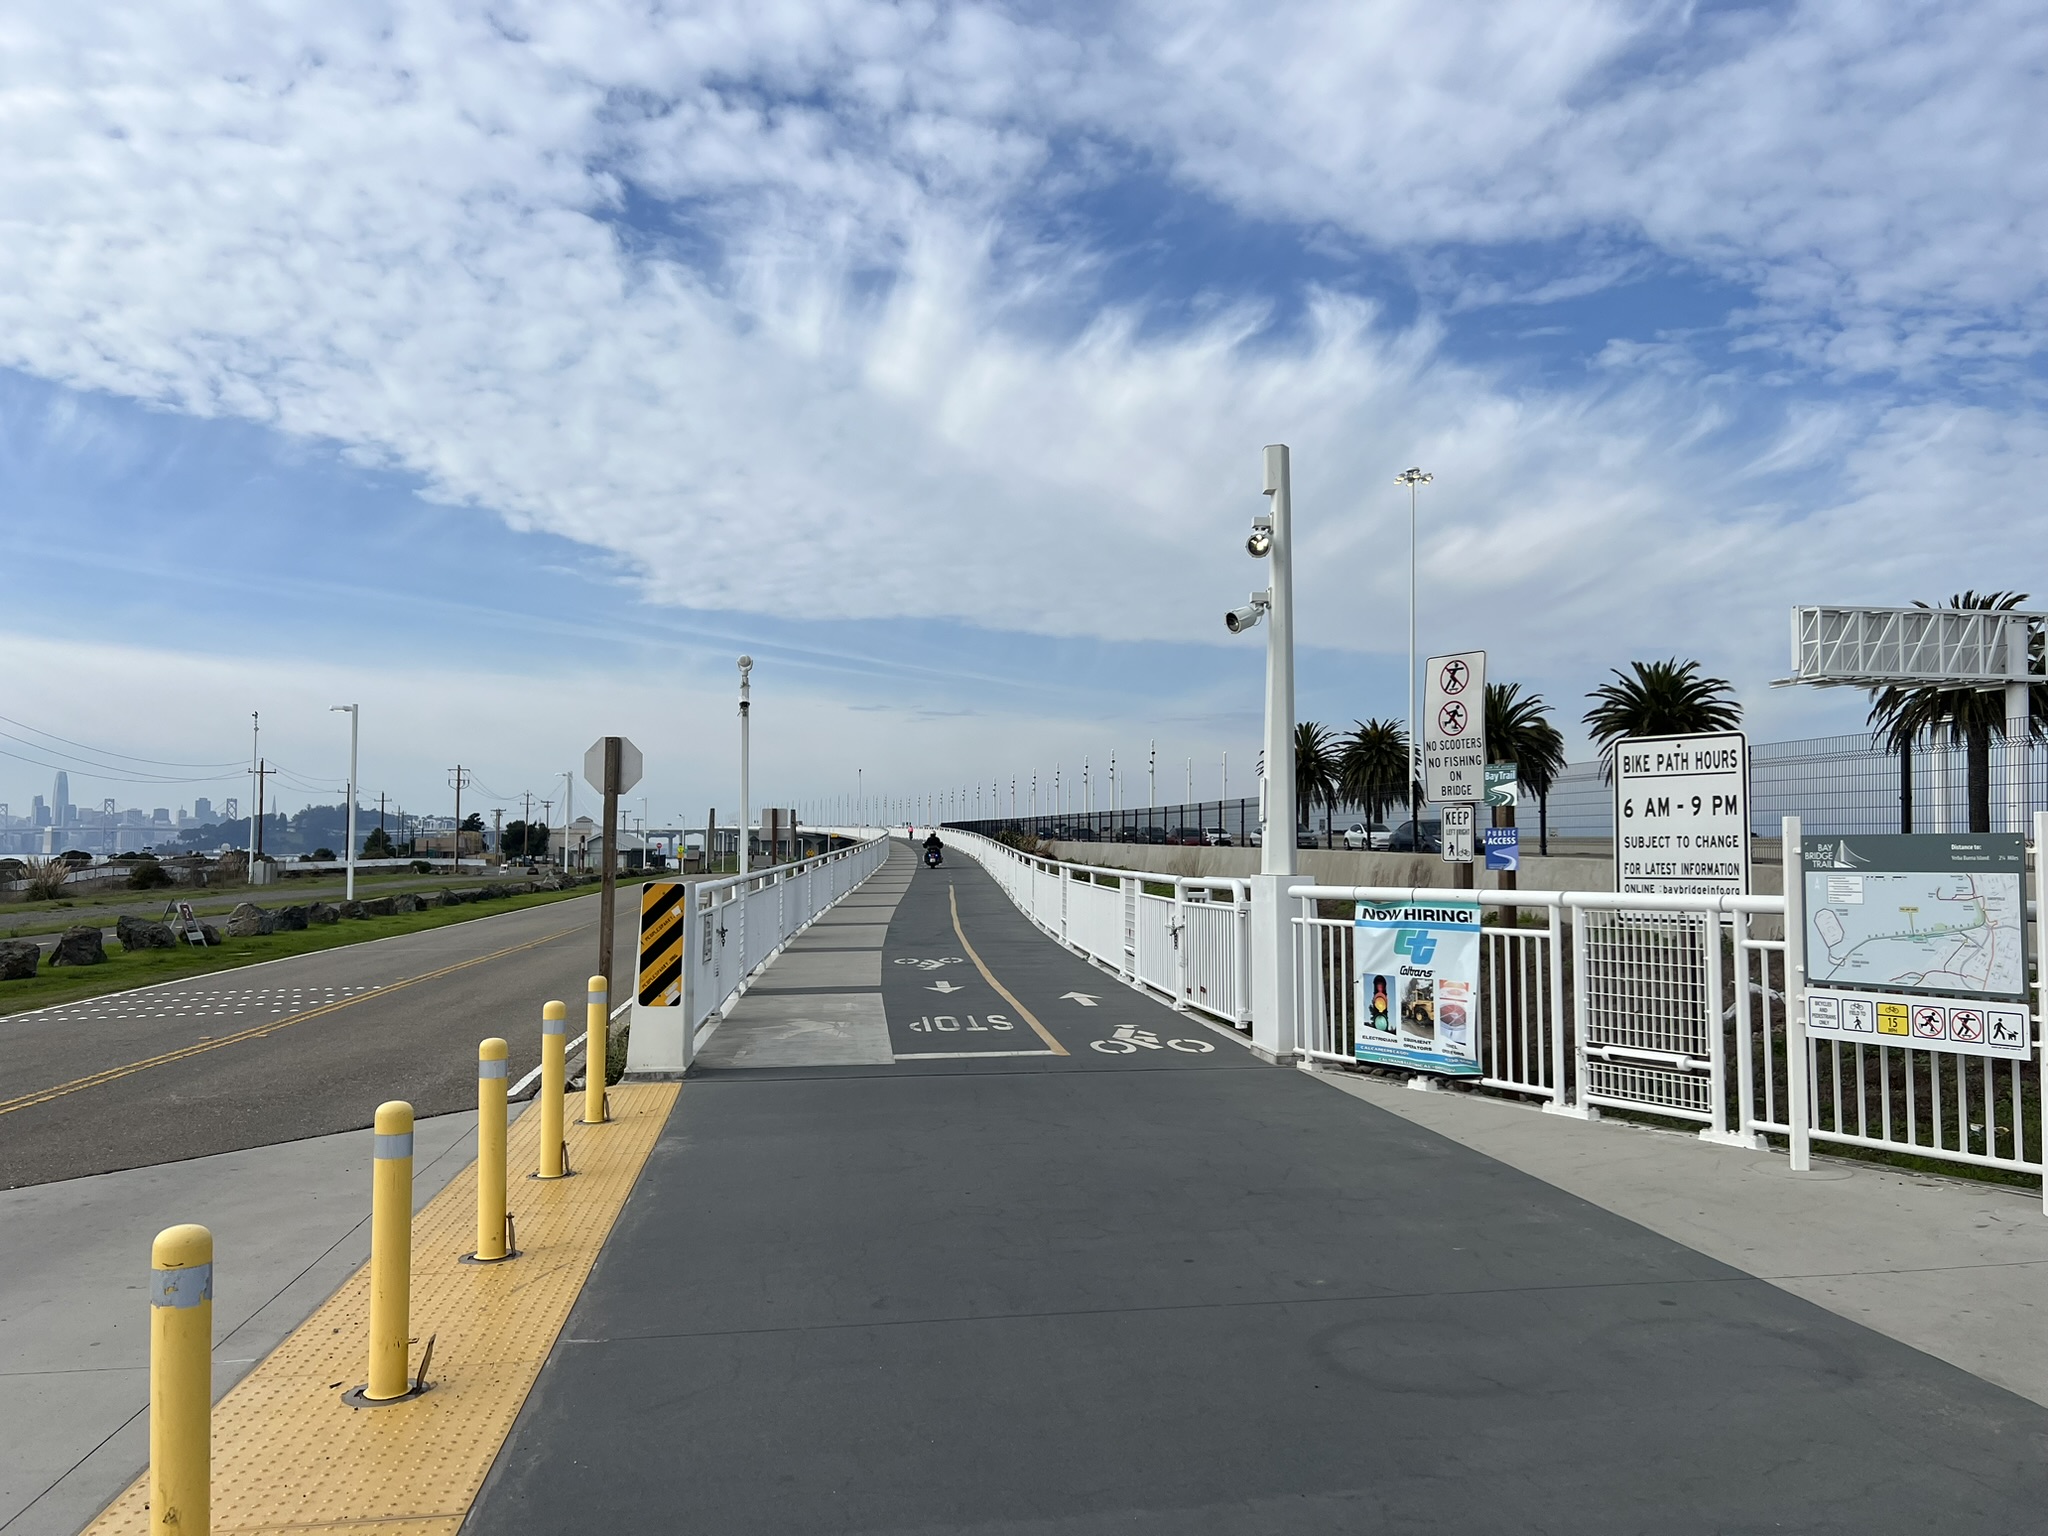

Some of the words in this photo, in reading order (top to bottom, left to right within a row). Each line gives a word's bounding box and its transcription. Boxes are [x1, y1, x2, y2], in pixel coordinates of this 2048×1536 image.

[1426, 740, 1437, 752] NO
[1440, 738, 1482, 751] SCOOTERS
[1428, 758, 1441, 768] NO
[1444, 755, 1482, 768] FISHING
[1624, 755, 1650, 774] BIKE
[1656, 752, 1689, 772] PATH
[1695, 749, 1738, 770] HOURS
[1450, 771, 1462, 782] ON
[1441, 785, 1472, 797] BRIDGE
[1624, 798, 1634, 818] 6
[1644, 797, 1670, 817] AM
[1691, 796, 1702, 816] 9
[1712, 795, 1738, 816] PM
[1446, 811, 1470, 825] KEEP
[1488, 837, 1516, 845] ACCESS
[1624, 836, 1670, 849] SUBJECT
[1676, 836, 1690, 848] TO
[1695, 835, 1739, 848] CHANGE
[1818, 844, 1833, 852] BAY
[1805, 852, 1833, 860] BRIDGE
[1624, 863, 1641, 875] FOR
[1645, 863, 1677, 875] LATEST
[1681, 863, 1740, 876] INFORMATION
[1812, 860, 1833, 868] TRAIL
[1624, 884, 1655, 894] ONLINE
[1362, 908, 1402, 921] NOW
[1404, 908, 1473, 923] HIRING!
[1400, 966, 1433, 978] Caltrans
[909, 1015, 1014, 1032] STOP
[1888, 1018, 1898, 1028] 15
[1362, 1035, 1398, 1044] ELECTRICIANS
